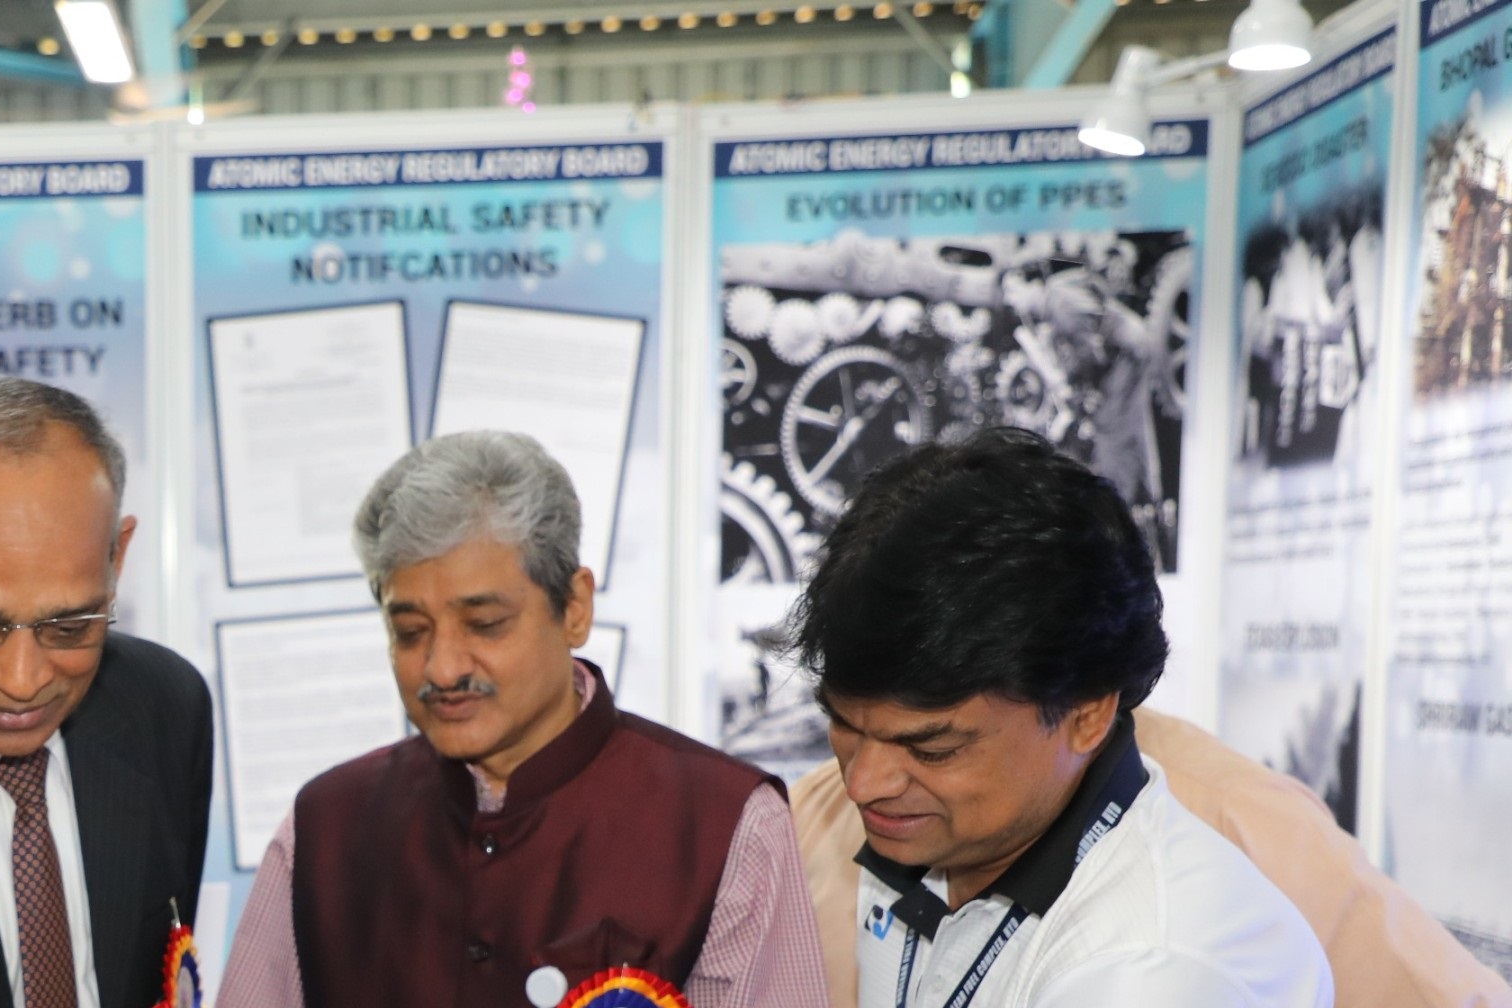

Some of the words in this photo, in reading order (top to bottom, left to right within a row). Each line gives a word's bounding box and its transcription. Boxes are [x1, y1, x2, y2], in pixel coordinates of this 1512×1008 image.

[208, 156, 302, 189] ATOMIC
[304, 154, 400, 186] ENERGY
[402, 148, 561, 184] REGULATORY
[562, 145, 648, 178] BOARD
[729, 141, 826, 174] ATOMIC
[828, 137, 929, 172] ENERGY
[47, 163, 129, 194] BOARD
[240, 204, 457, 239] INDUSTRIAL
[471, 198, 611, 233] SAFETY
[786, 189, 976, 223] EVOLUTION
[992, 184, 1029, 211] OF
[1039, 180, 1126, 209] PPES
[68, 297, 123, 329] ON
[963, 972, 979, 996] FUEL
